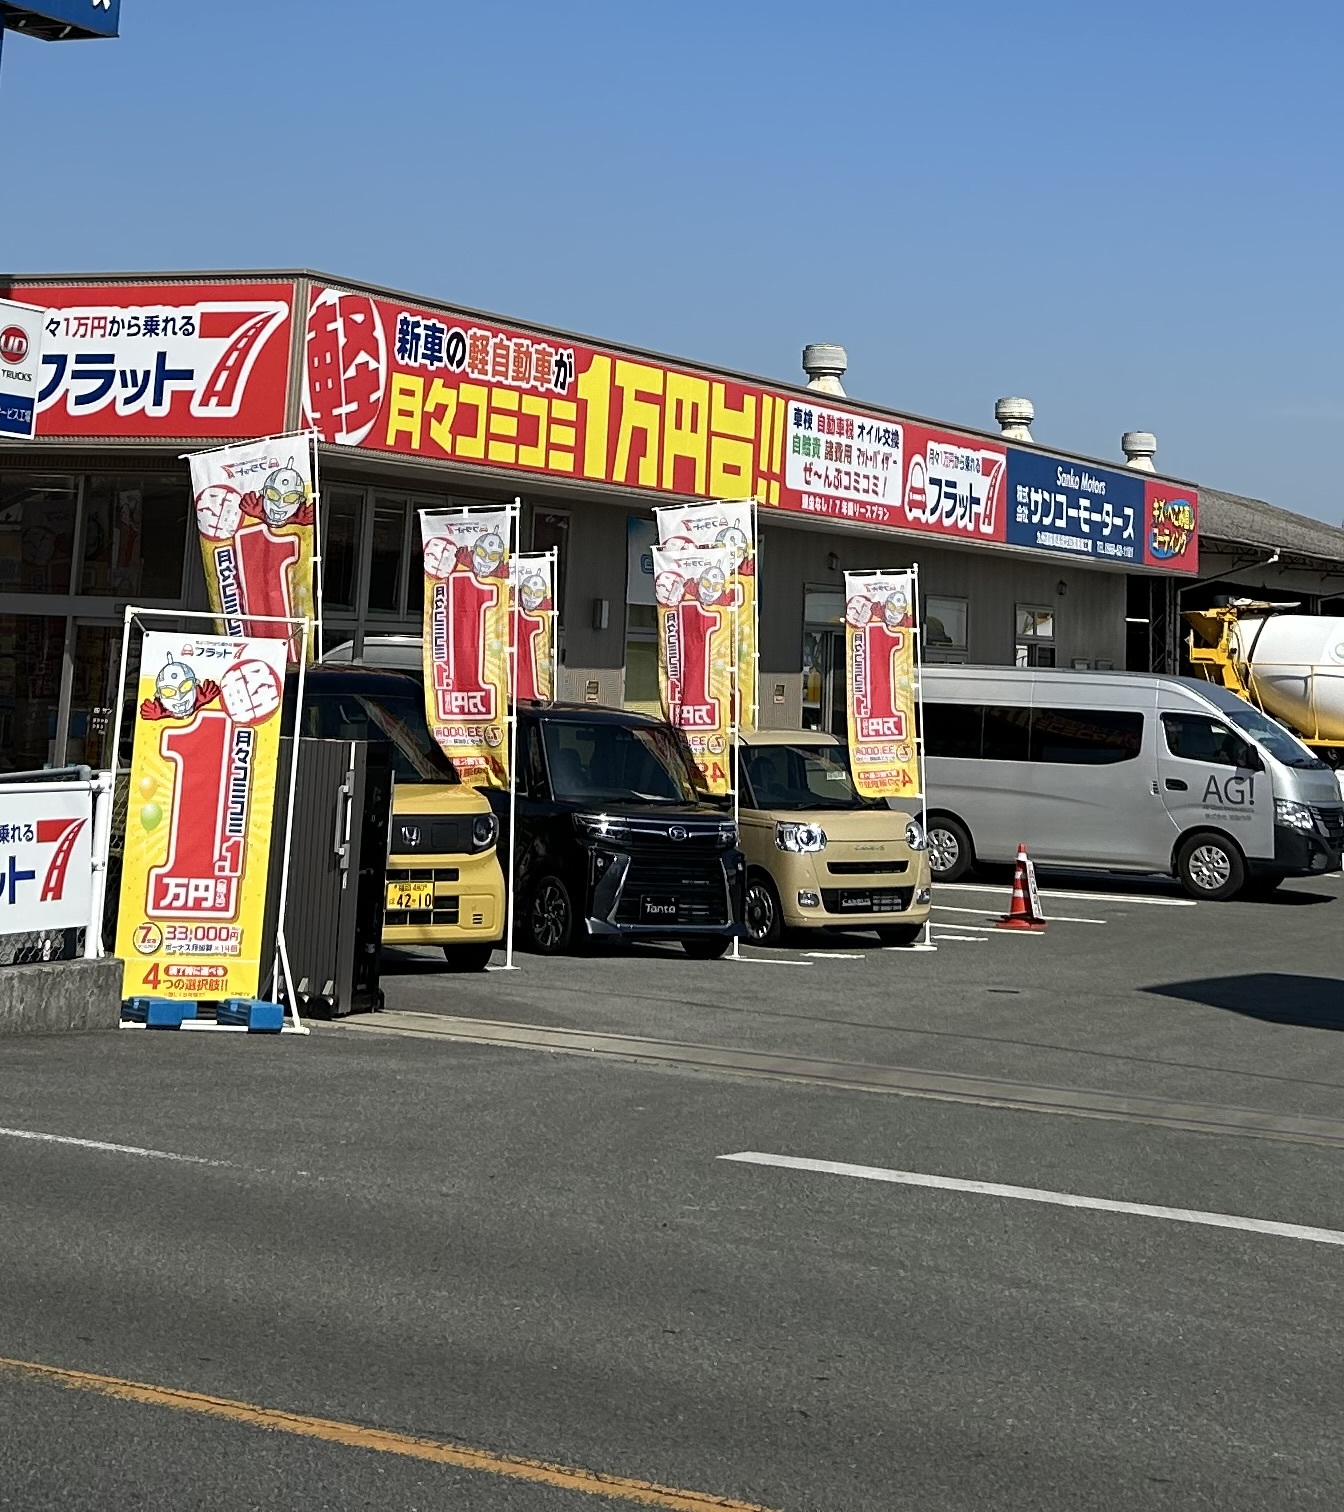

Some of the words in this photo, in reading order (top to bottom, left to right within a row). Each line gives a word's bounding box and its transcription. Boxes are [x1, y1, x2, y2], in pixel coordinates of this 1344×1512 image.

[303, 288, 386, 445] 軽
[397, 314, 574, 392] 新車の軽自動車が
[2, 368, 33, 382] TRUCKS
[386, 372, 578, 473] 月々コミコミ
[793, 407, 814, 431] 車検
[1056, 465, 1080, 490] Sanko
[1081, 472, 1106, 496] Motors
[928, 476, 981, 523] フラット
[1030, 487, 1135, 541] サンコーモータース
[228, 729, 252, 834] 月々コミコミ
[1202, 774, 1255, 806] AG!
[159, 877, 216, 909] 万円
[644, 902, 676, 914] Tanto
[142, 962, 162, 990] 4
